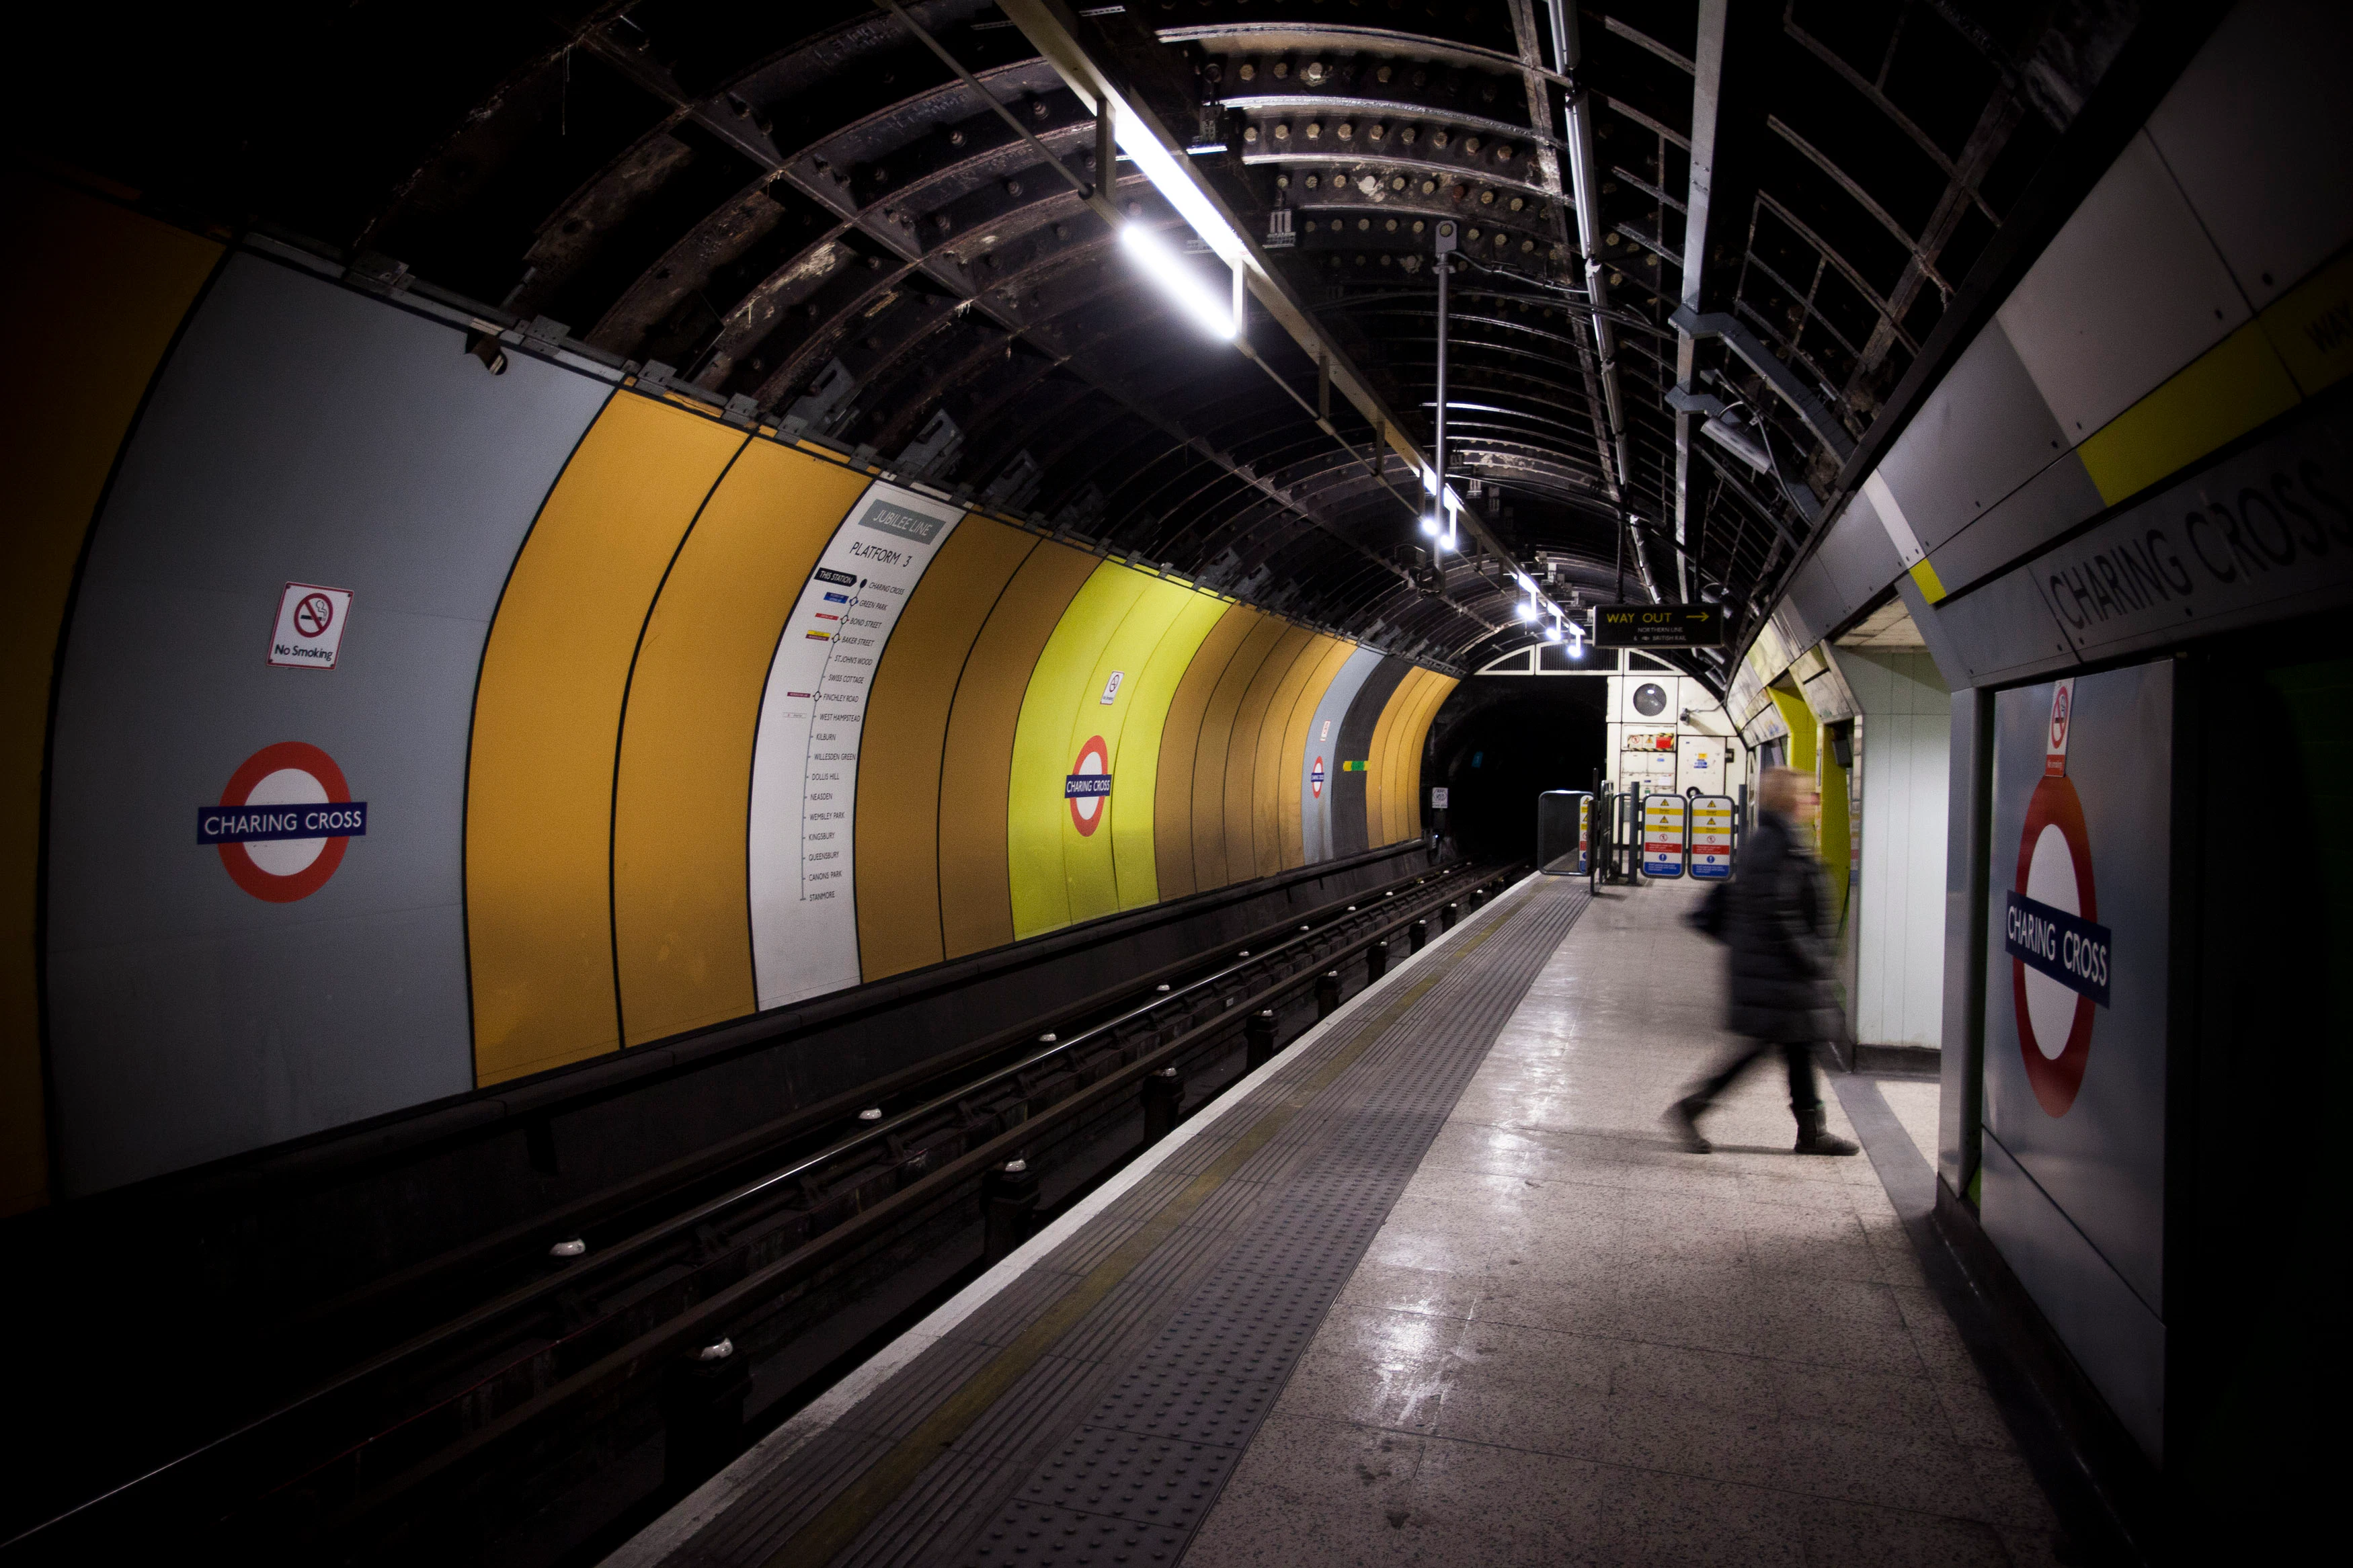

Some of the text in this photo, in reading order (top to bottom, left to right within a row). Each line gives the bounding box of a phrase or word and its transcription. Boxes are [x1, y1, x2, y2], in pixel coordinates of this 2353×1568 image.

[873, 509, 932, 536] JUBILEE LINE
[2050, 459, 2352, 629] CHARING CROSS
[849, 542, 912, 567] PLATFORM 3
[819, 571, 853, 585] THIS STATION
[869, 582, 905, 595] CHARING CROSS
[860, 600, 887, 611] GREEN PARK
[850, 618, 882, 629] BOND STREET
[1606, 612, 1672, 624] WAY OUT
[856, 638, 875, 647] STREET
[274, 644, 333, 662] No Smoking
[857, 658, 873, 666] WOOD
[842, 675, 865, 684] COTTAGE
[823, 693, 846, 702] FINCHLEY
[820, 713, 861, 723] WEST HAMPSTEAD
[1066, 780, 1111, 792] CHARING CROSS
[809, 813, 833, 821] WEMBLEY
[204, 811, 362, 835] CHARING CROSS
[808, 832, 835, 841] KINGSBURY
[808, 852, 839, 861] QUEENSBURY
[809, 870, 842, 882] CANONS PARK
[809, 891, 836, 901] STANMORE
[2007, 905, 2108, 987] CHARING CROSS
